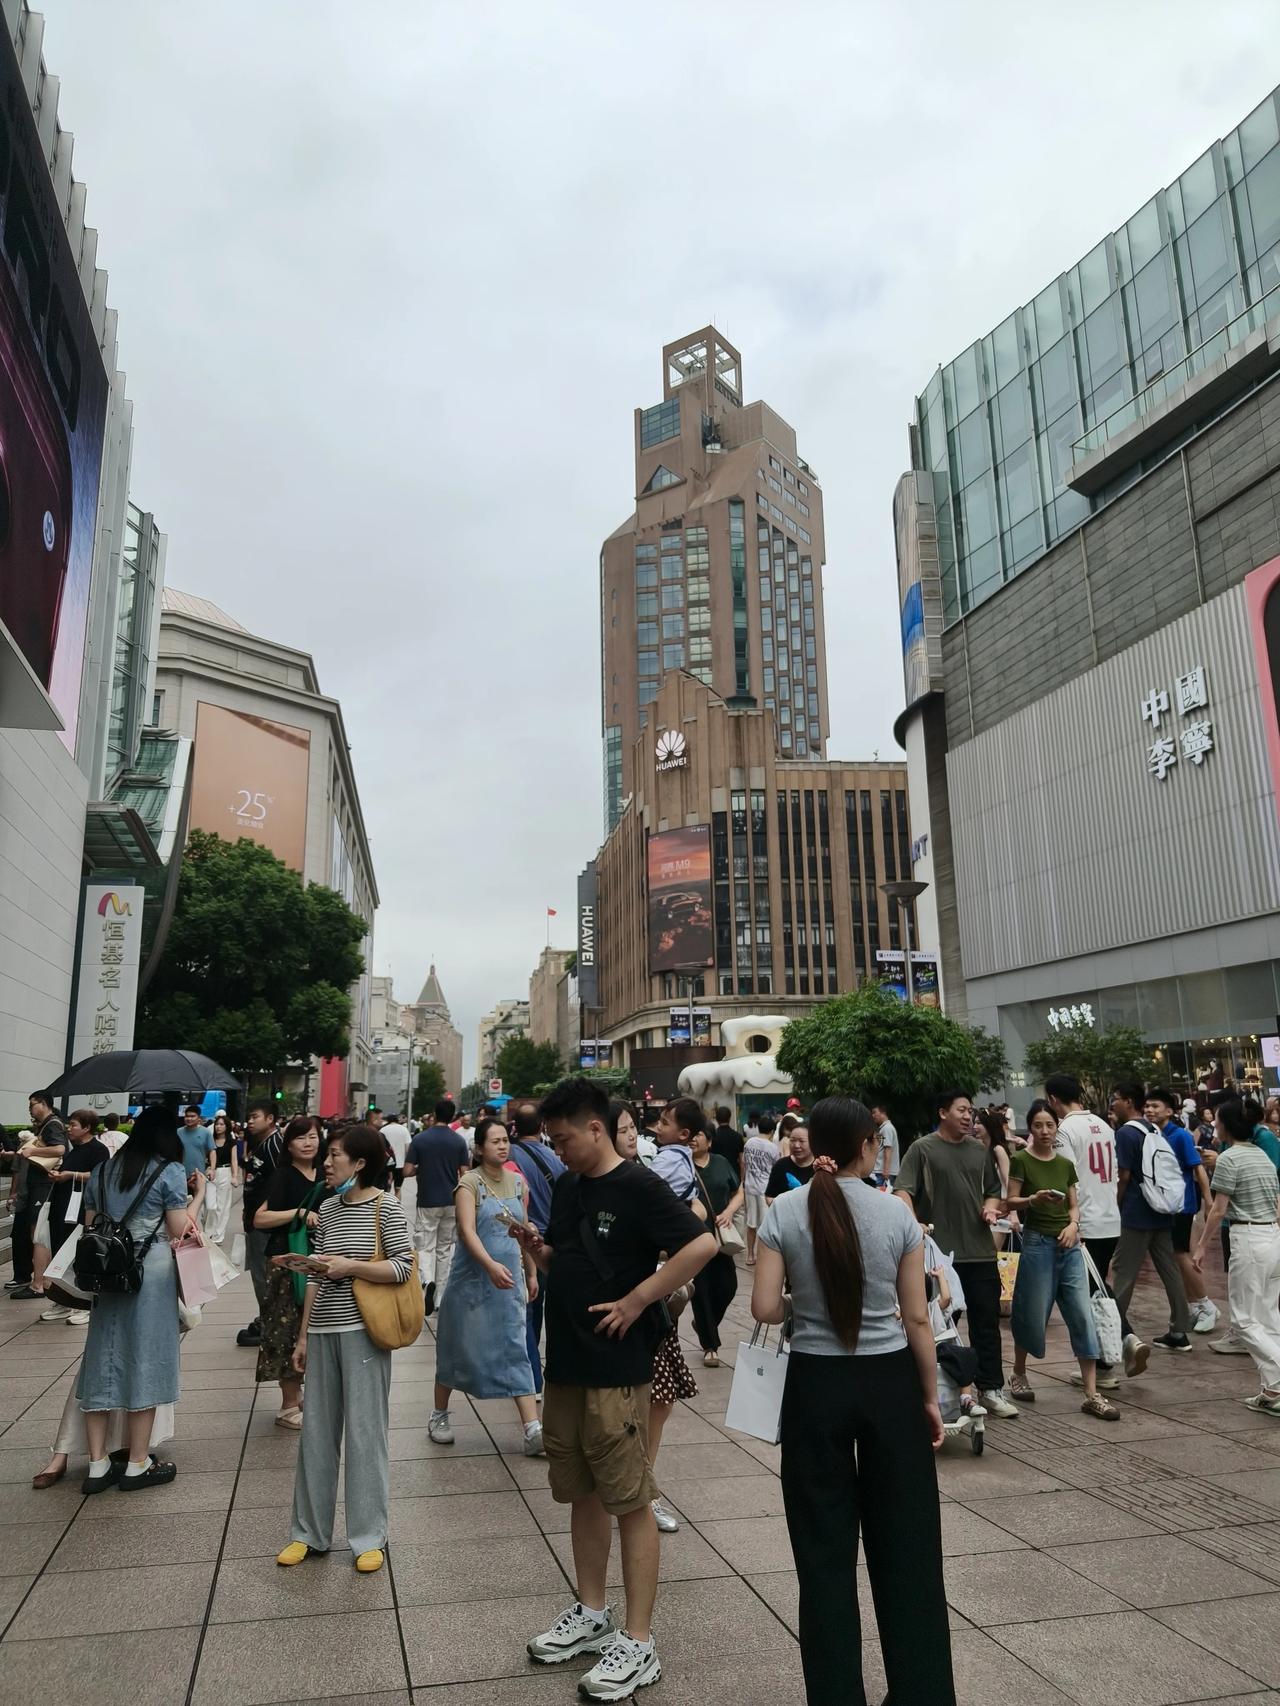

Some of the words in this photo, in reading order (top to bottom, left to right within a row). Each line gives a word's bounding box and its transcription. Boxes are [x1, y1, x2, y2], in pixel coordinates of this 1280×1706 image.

[1141, 665, 1208, 728] 中國
[655, 757, 687, 771] HUAWEI
[1147, 720, 1213, 780] 李寧
[582, 905, 594, 966] HUAWEI
[88, 919, 126, 1110] 恒基名人购物心
[1088, 1141, 1112, 1184] 41
